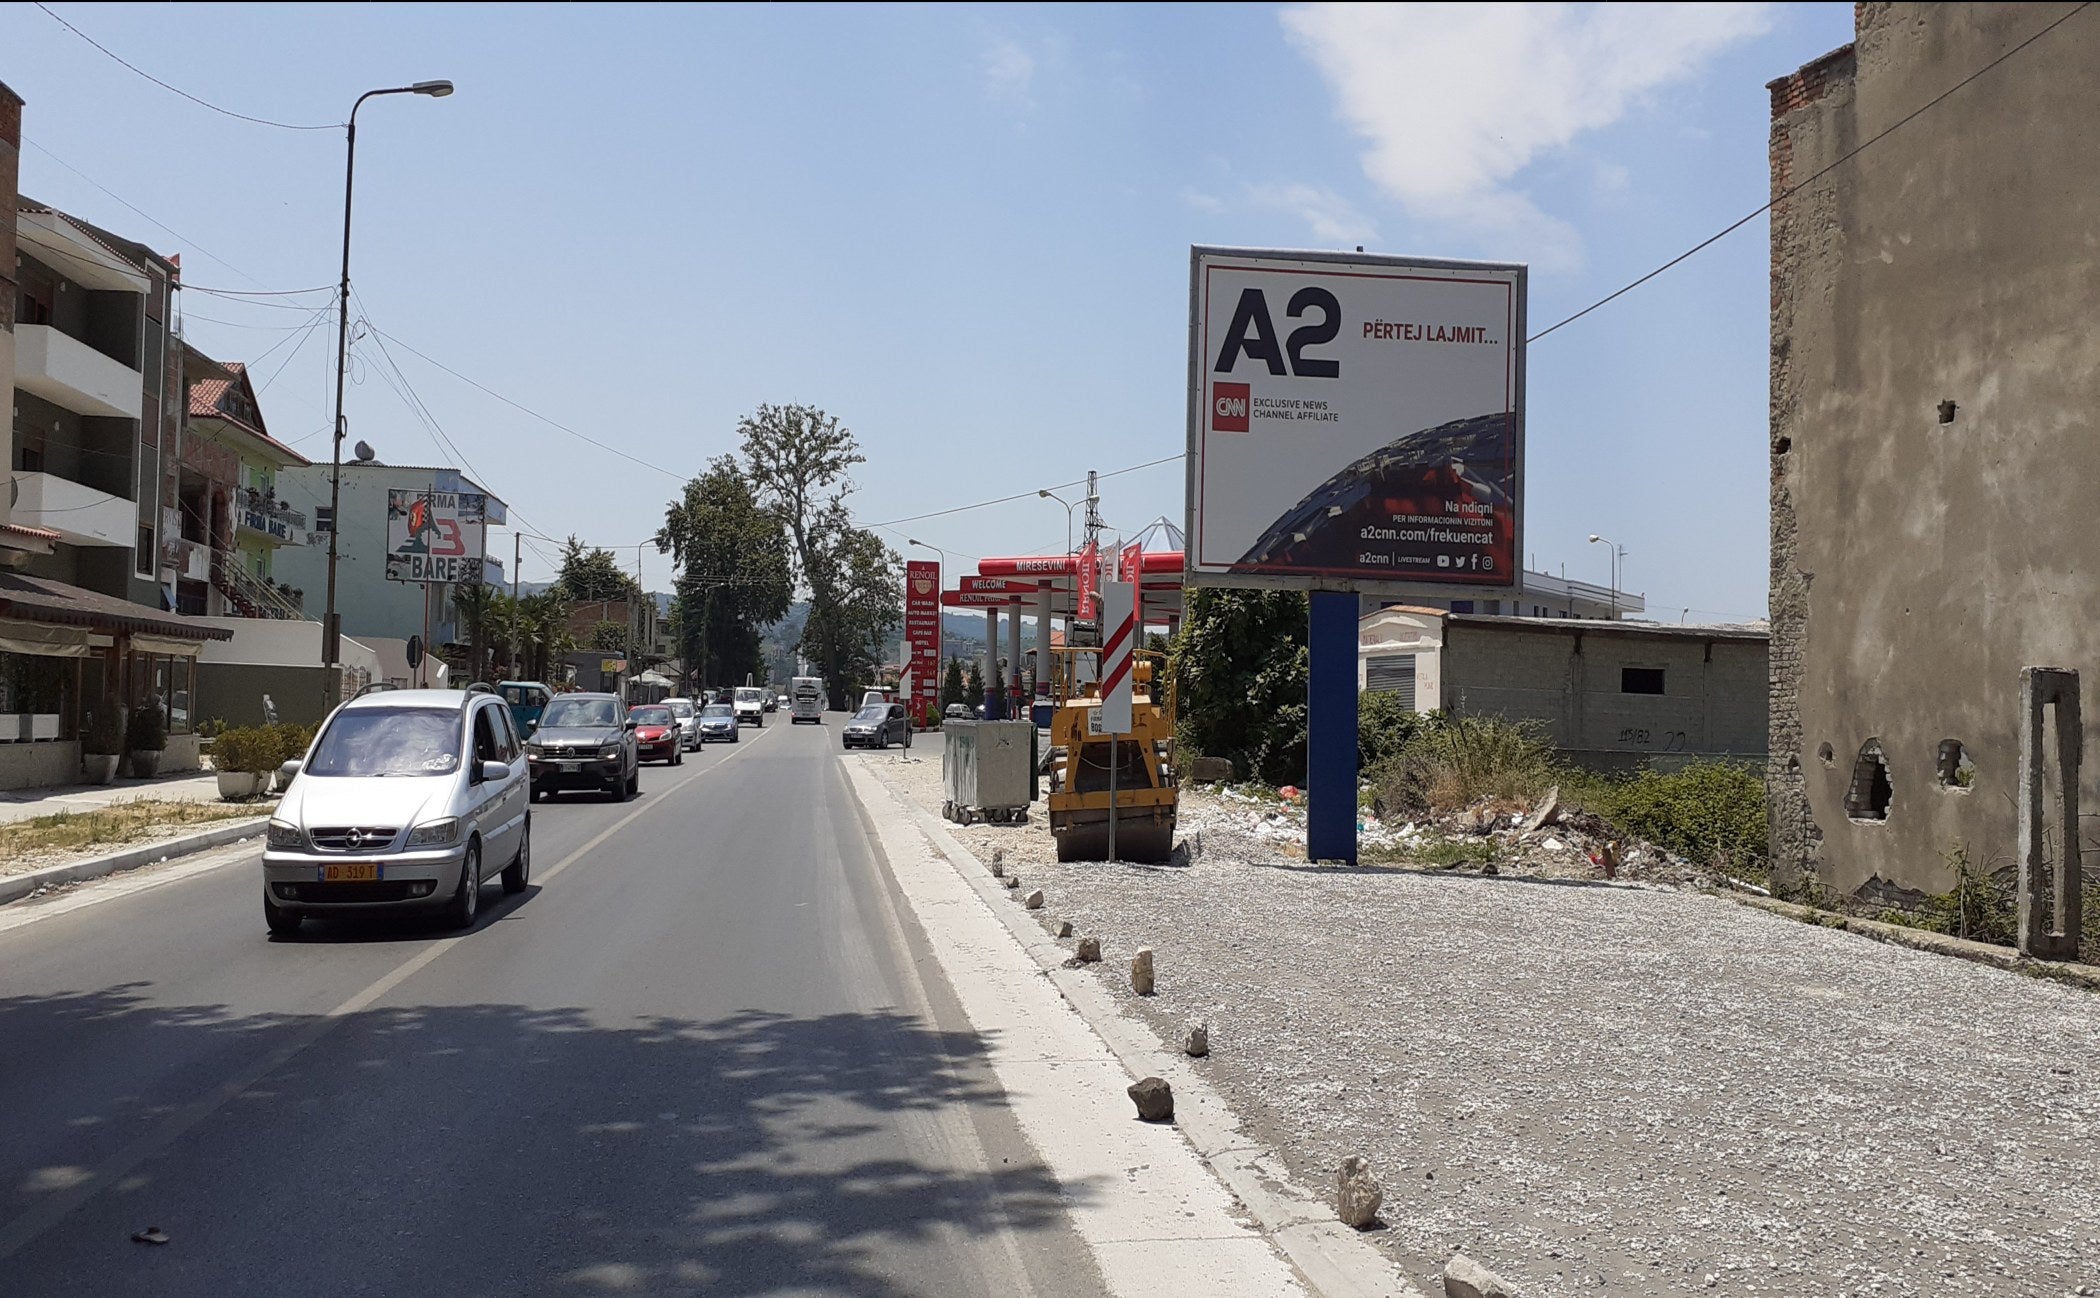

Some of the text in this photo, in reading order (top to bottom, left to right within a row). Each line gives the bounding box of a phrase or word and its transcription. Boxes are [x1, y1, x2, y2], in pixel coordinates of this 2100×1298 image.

[1213, 286, 1342, 379] A2
[1362, 318, 1498, 344] PËRTEJ LAJMIT...
[1215, 397, 1246, 417] CNN
[1253, 398, 1328, 411] EXCLUSIVE NEWS
[1253, 409, 1339, 422] CHANNEL AFFILIATE
[1445, 500, 1493, 516] Na ndiqni
[1392, 514, 1493, 527] PER INFORMACIONIN VIZITONI
[1360, 525, 1493, 544] a2cnn.com/frekuencat
[1359, 552, 1431, 564] a2cnn LIVESTREAM
[412, 555, 458, 581] BARE
[1016, 560, 1066, 572] MIRESEVINI
[909, 570, 937, 580] RENOIL
[971, 580, 1006, 589] WELCOME
[327, 866, 339, 879] AD
[368, 865, 374, 878] T
